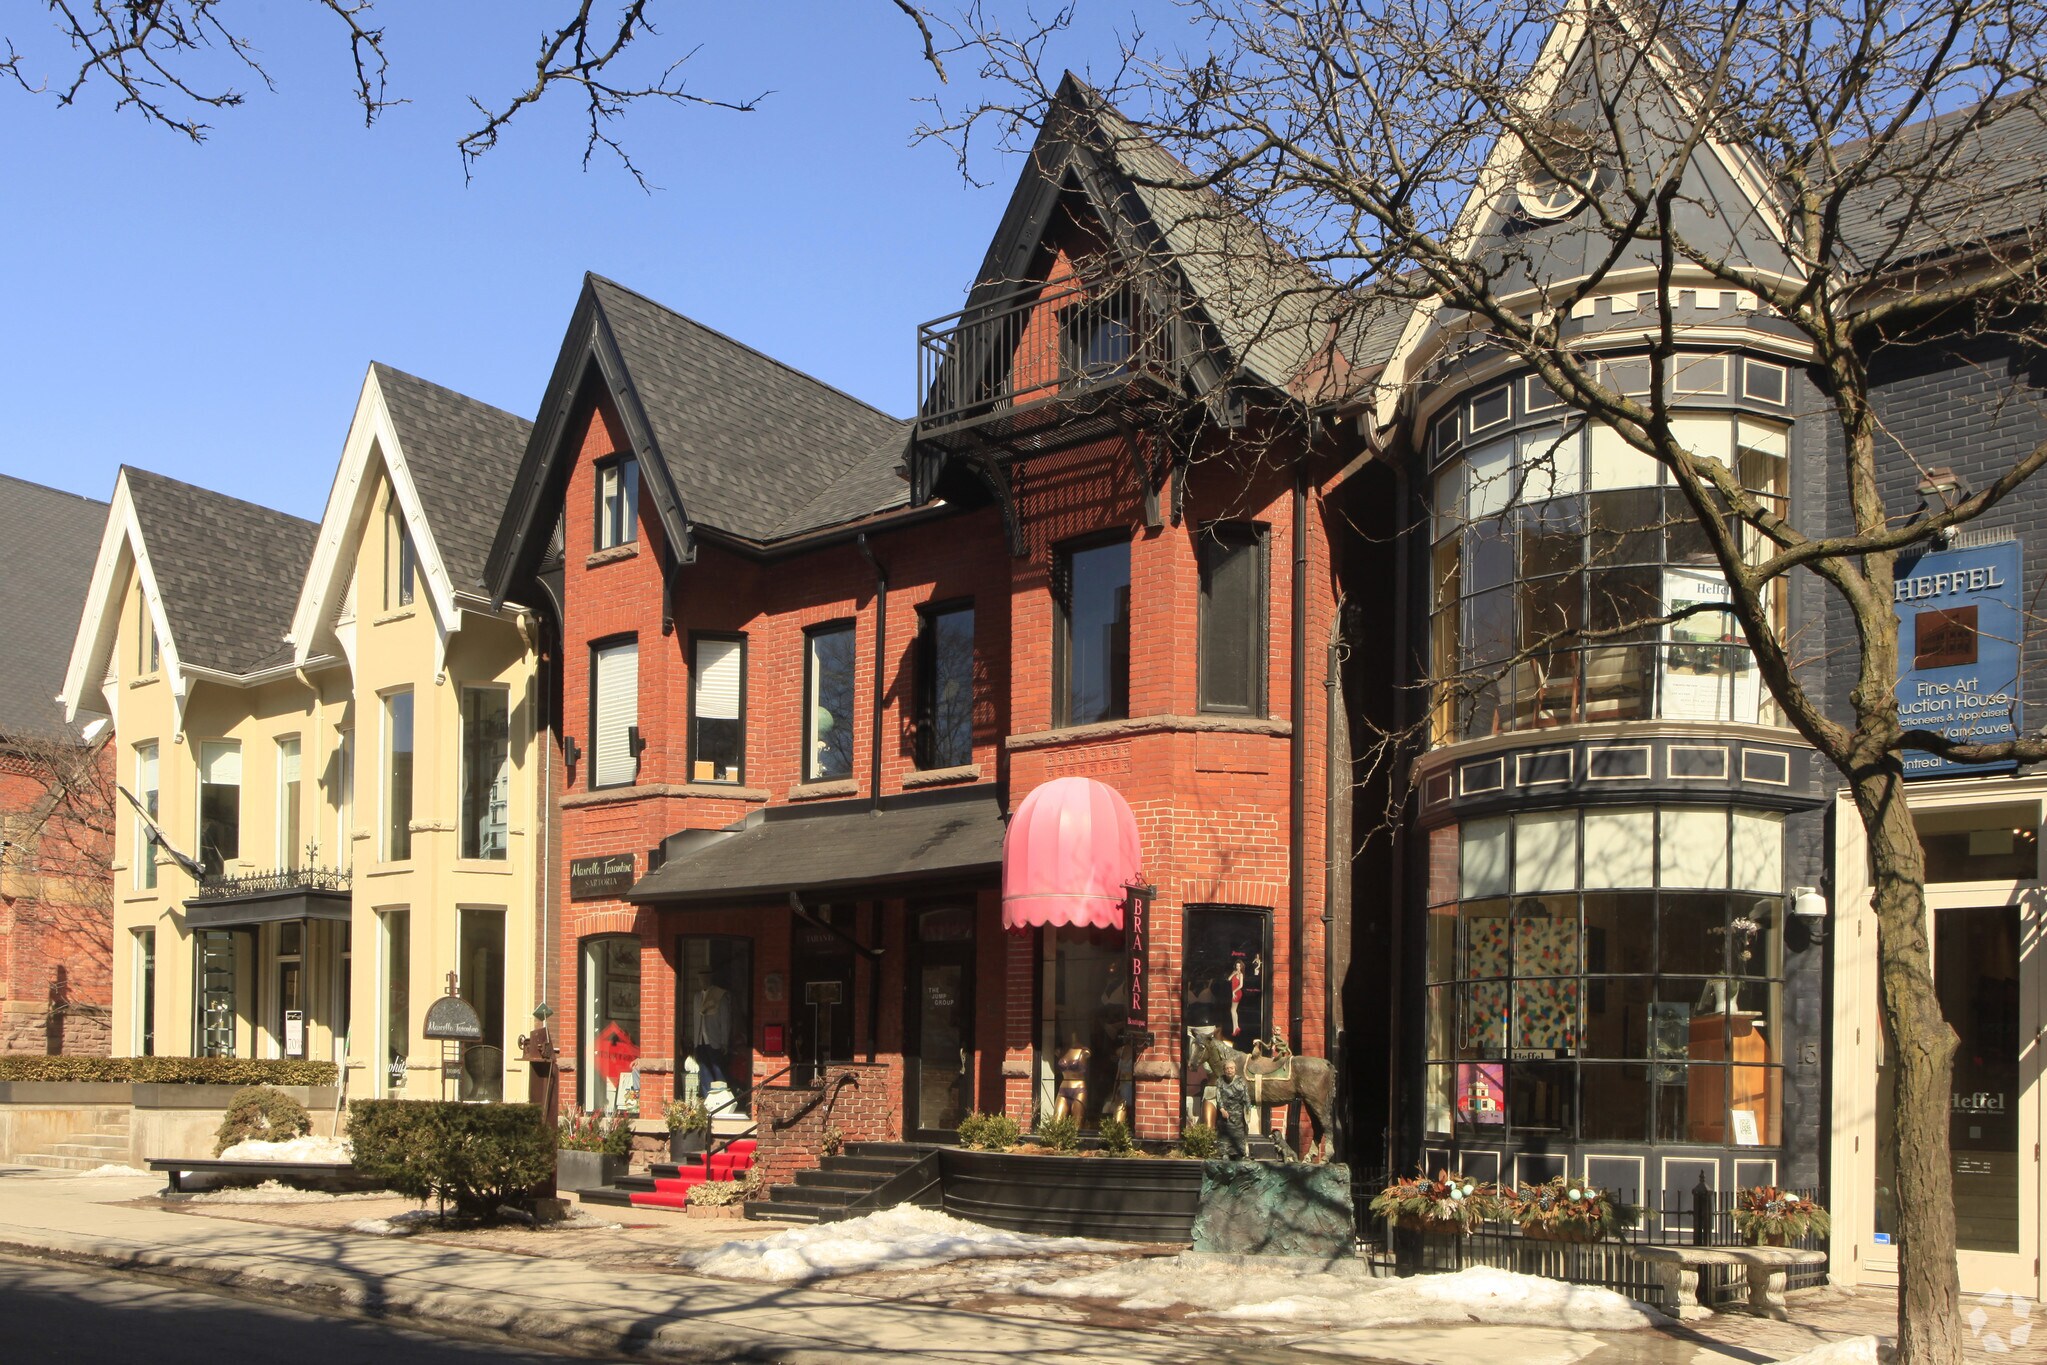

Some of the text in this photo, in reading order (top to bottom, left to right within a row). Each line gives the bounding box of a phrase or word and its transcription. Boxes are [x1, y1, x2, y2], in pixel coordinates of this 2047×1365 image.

[1894, 565, 2005, 601] HEFFEL
[1917, 677, 1979, 697] Fine Art
[1897, 698, 1951, 715] uction
[1898, 715, 1945, 727] ctioneers
[1946, 713, 1955, 722] &
[1902, 756, 1942, 770] ontreal
[585, 877, 618, 888] SARTORIA
[1132, 898, 1142, 1010] BRA BAR
